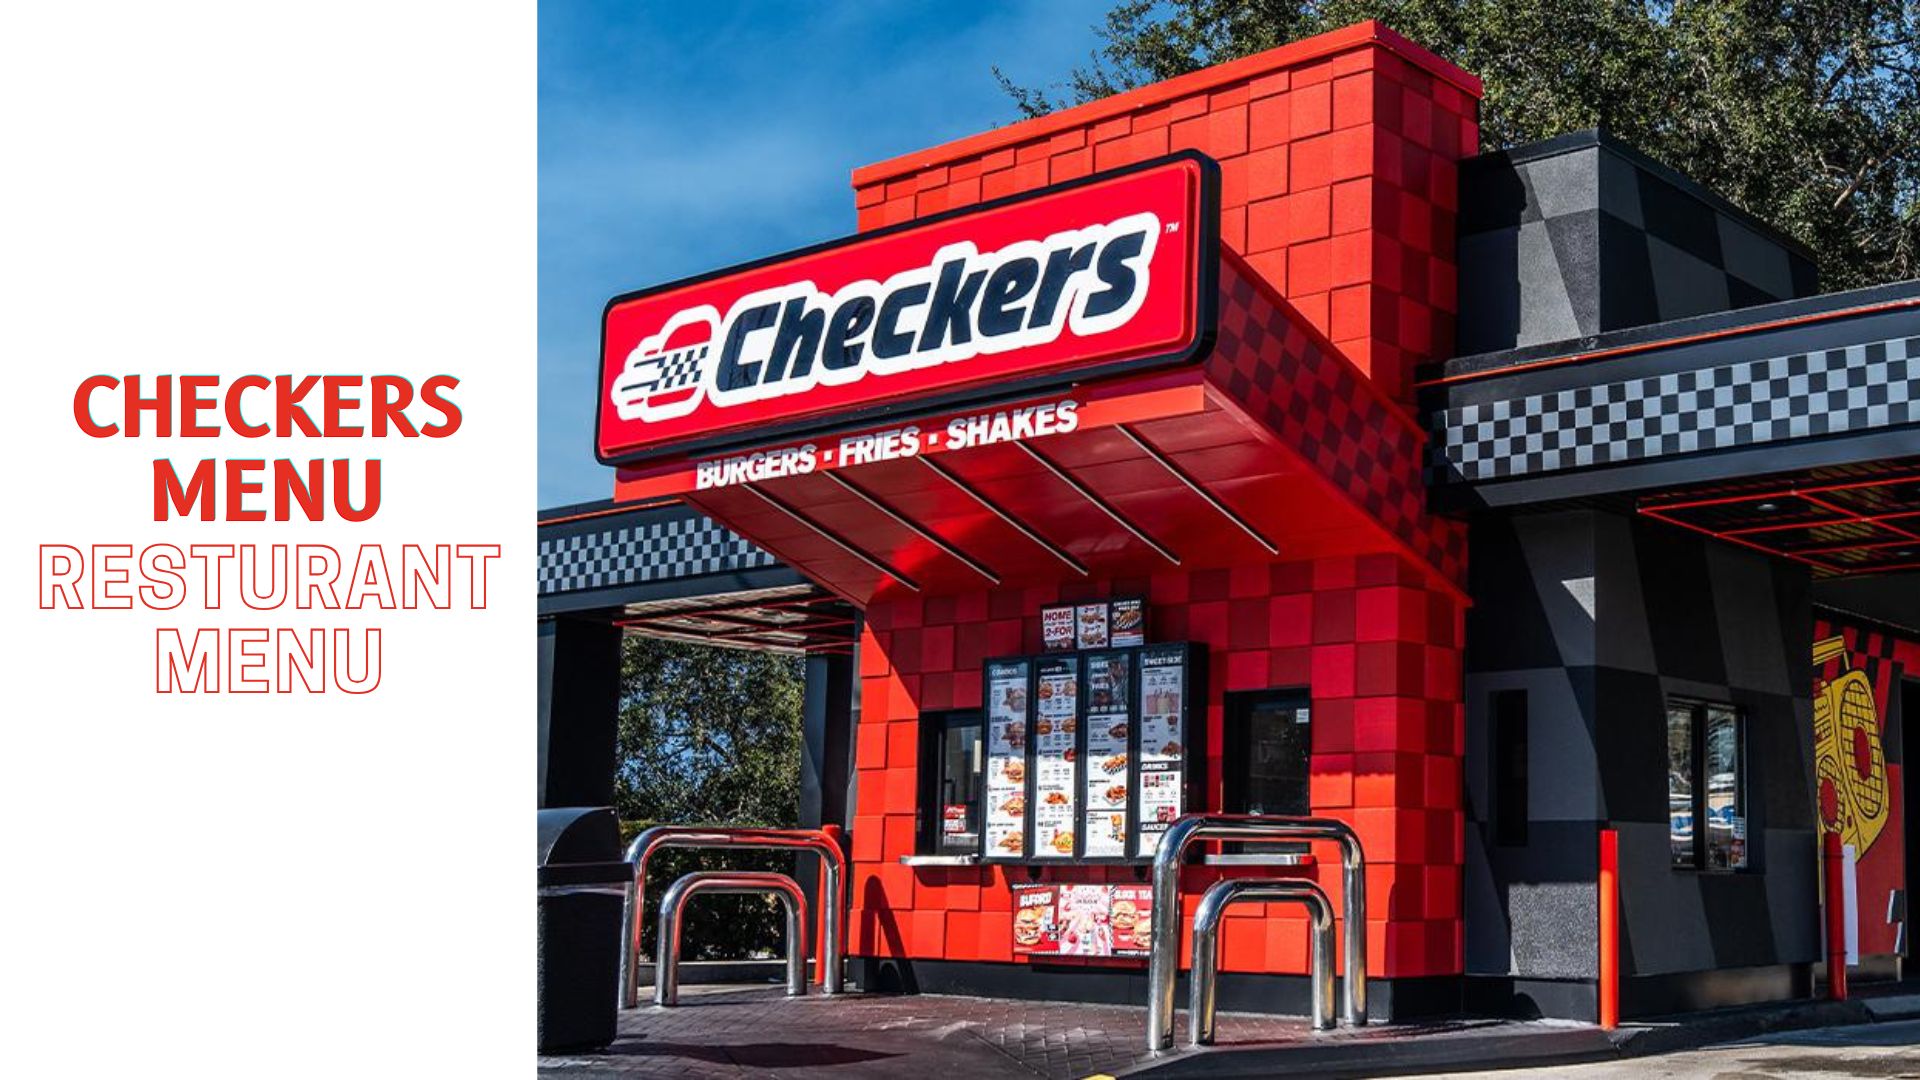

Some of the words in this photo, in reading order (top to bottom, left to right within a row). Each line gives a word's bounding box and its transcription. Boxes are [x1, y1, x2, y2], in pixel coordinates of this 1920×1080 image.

[715, 229, 1148, 393] Checkers
[696, 443, 818, 490] BURGERS
[838, 425, 921, 467] FRIES
[945, 400, 1079, 450] SHAKES
[1044, 610, 1072, 621] HOME
